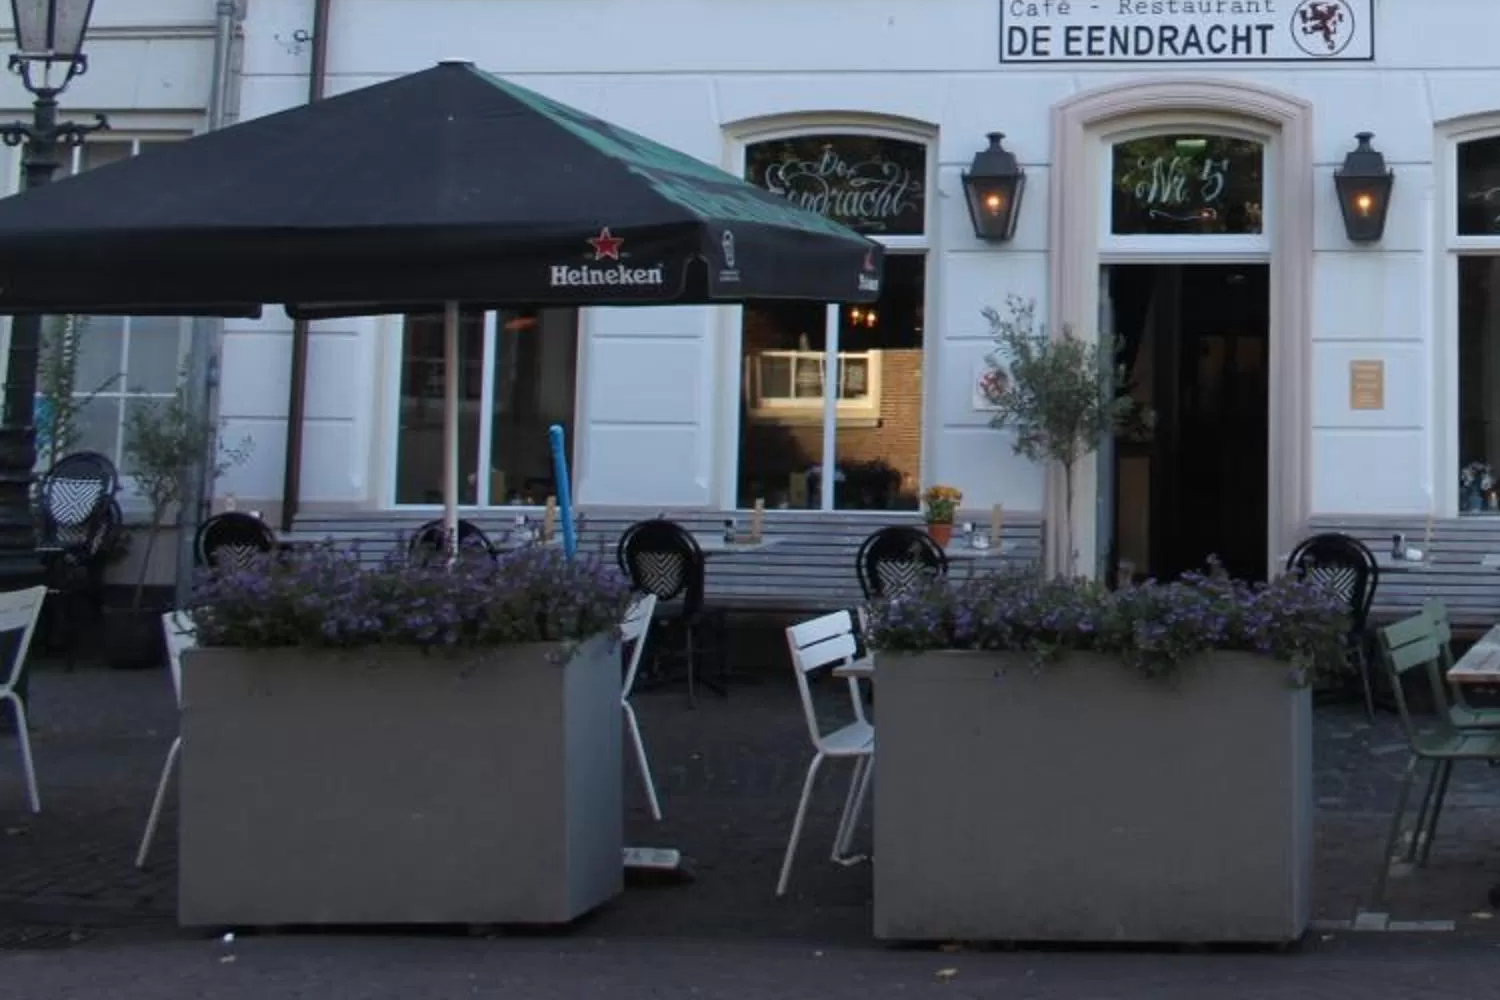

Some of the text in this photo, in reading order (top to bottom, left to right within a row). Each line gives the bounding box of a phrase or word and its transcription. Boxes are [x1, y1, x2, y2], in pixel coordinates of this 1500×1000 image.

[1006, 24, 1275, 56] DE EENDRACHT
[550, 264, 664, 286] Heineken
